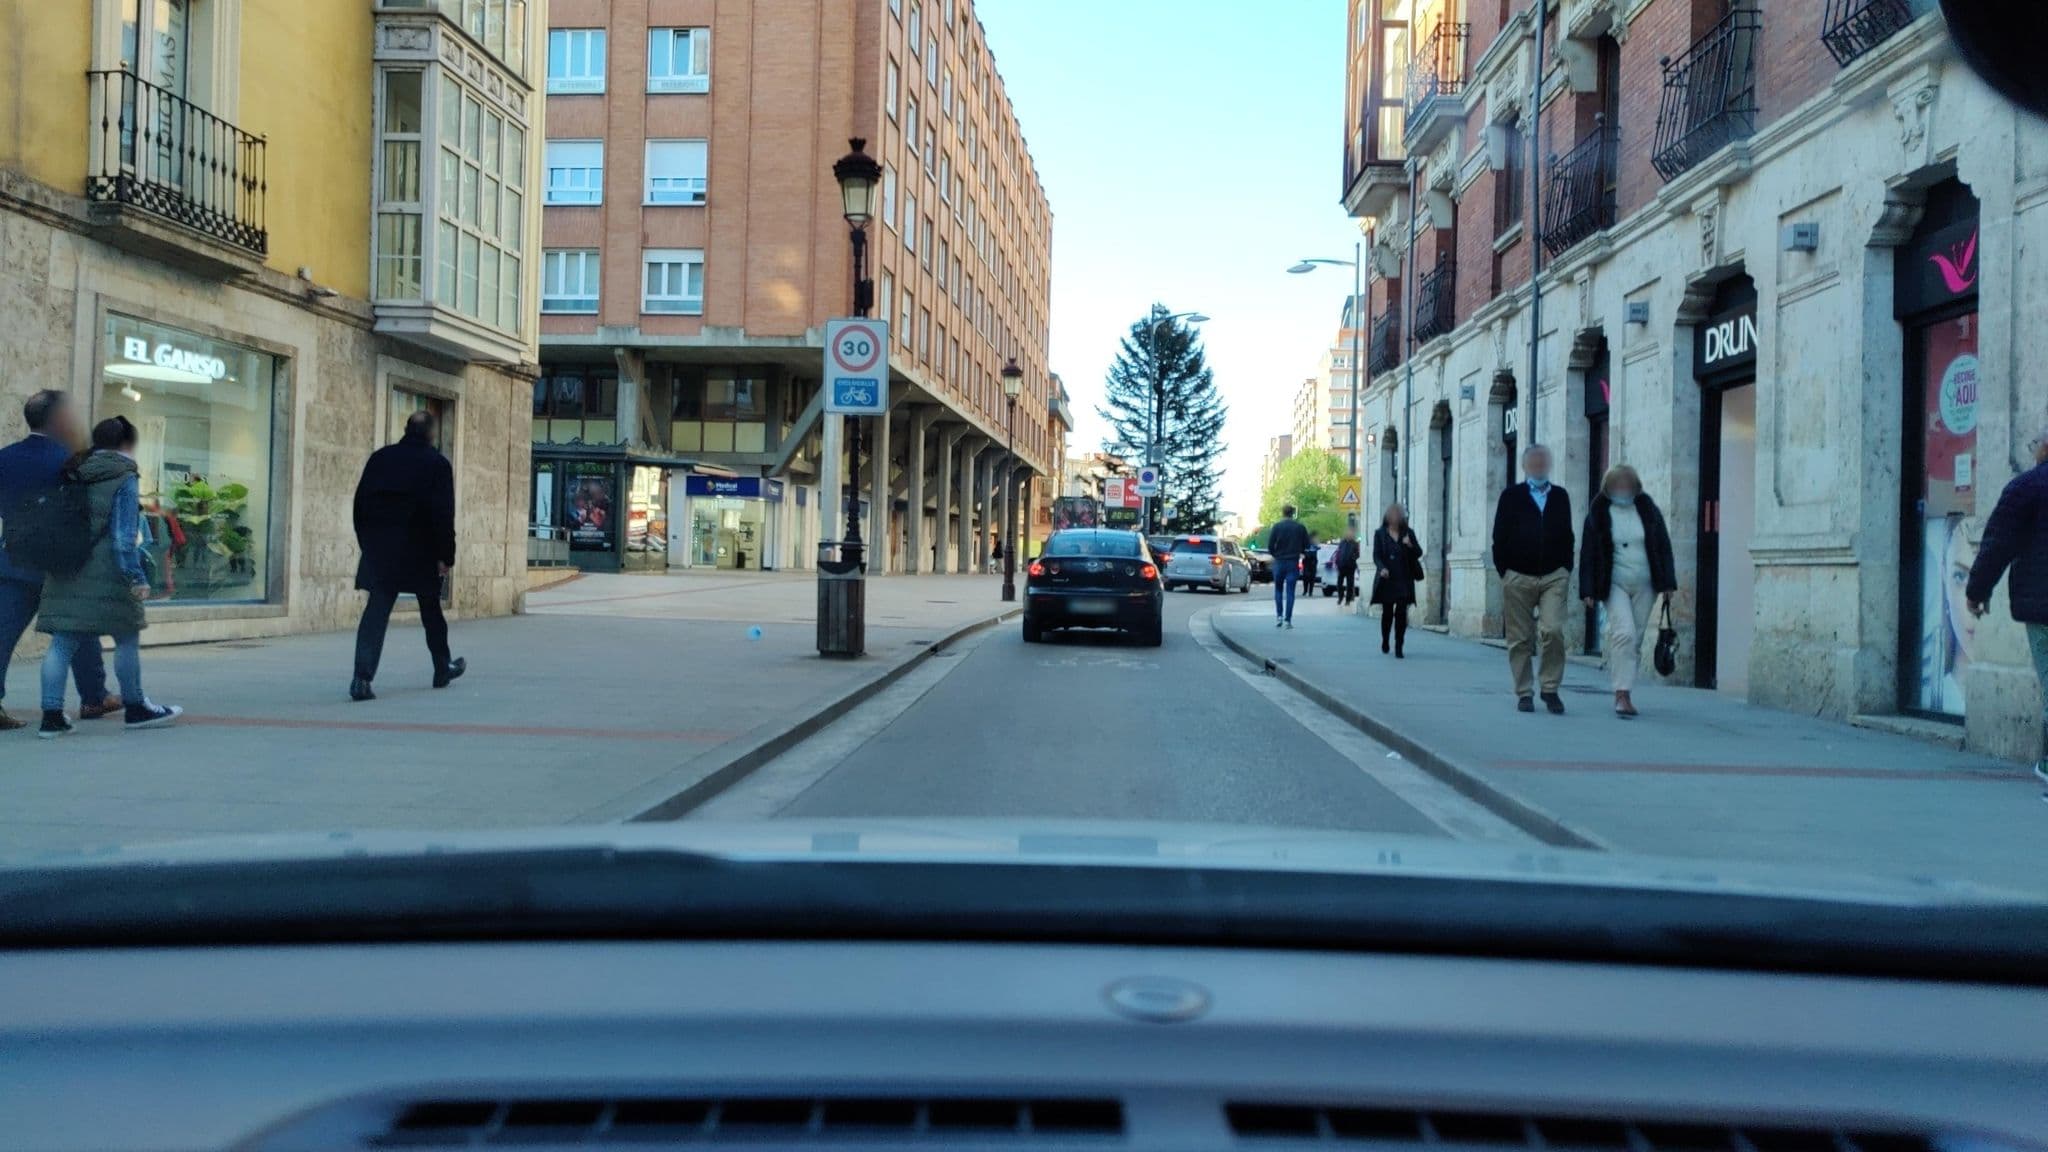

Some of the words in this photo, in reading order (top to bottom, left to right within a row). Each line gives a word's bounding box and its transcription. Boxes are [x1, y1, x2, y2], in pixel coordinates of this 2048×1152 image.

[124, 336, 152, 363] EL
[154, 343, 226, 379] GANSO
[843, 341, 870, 356] 30
[1705, 314, 1758, 364] DRUN
